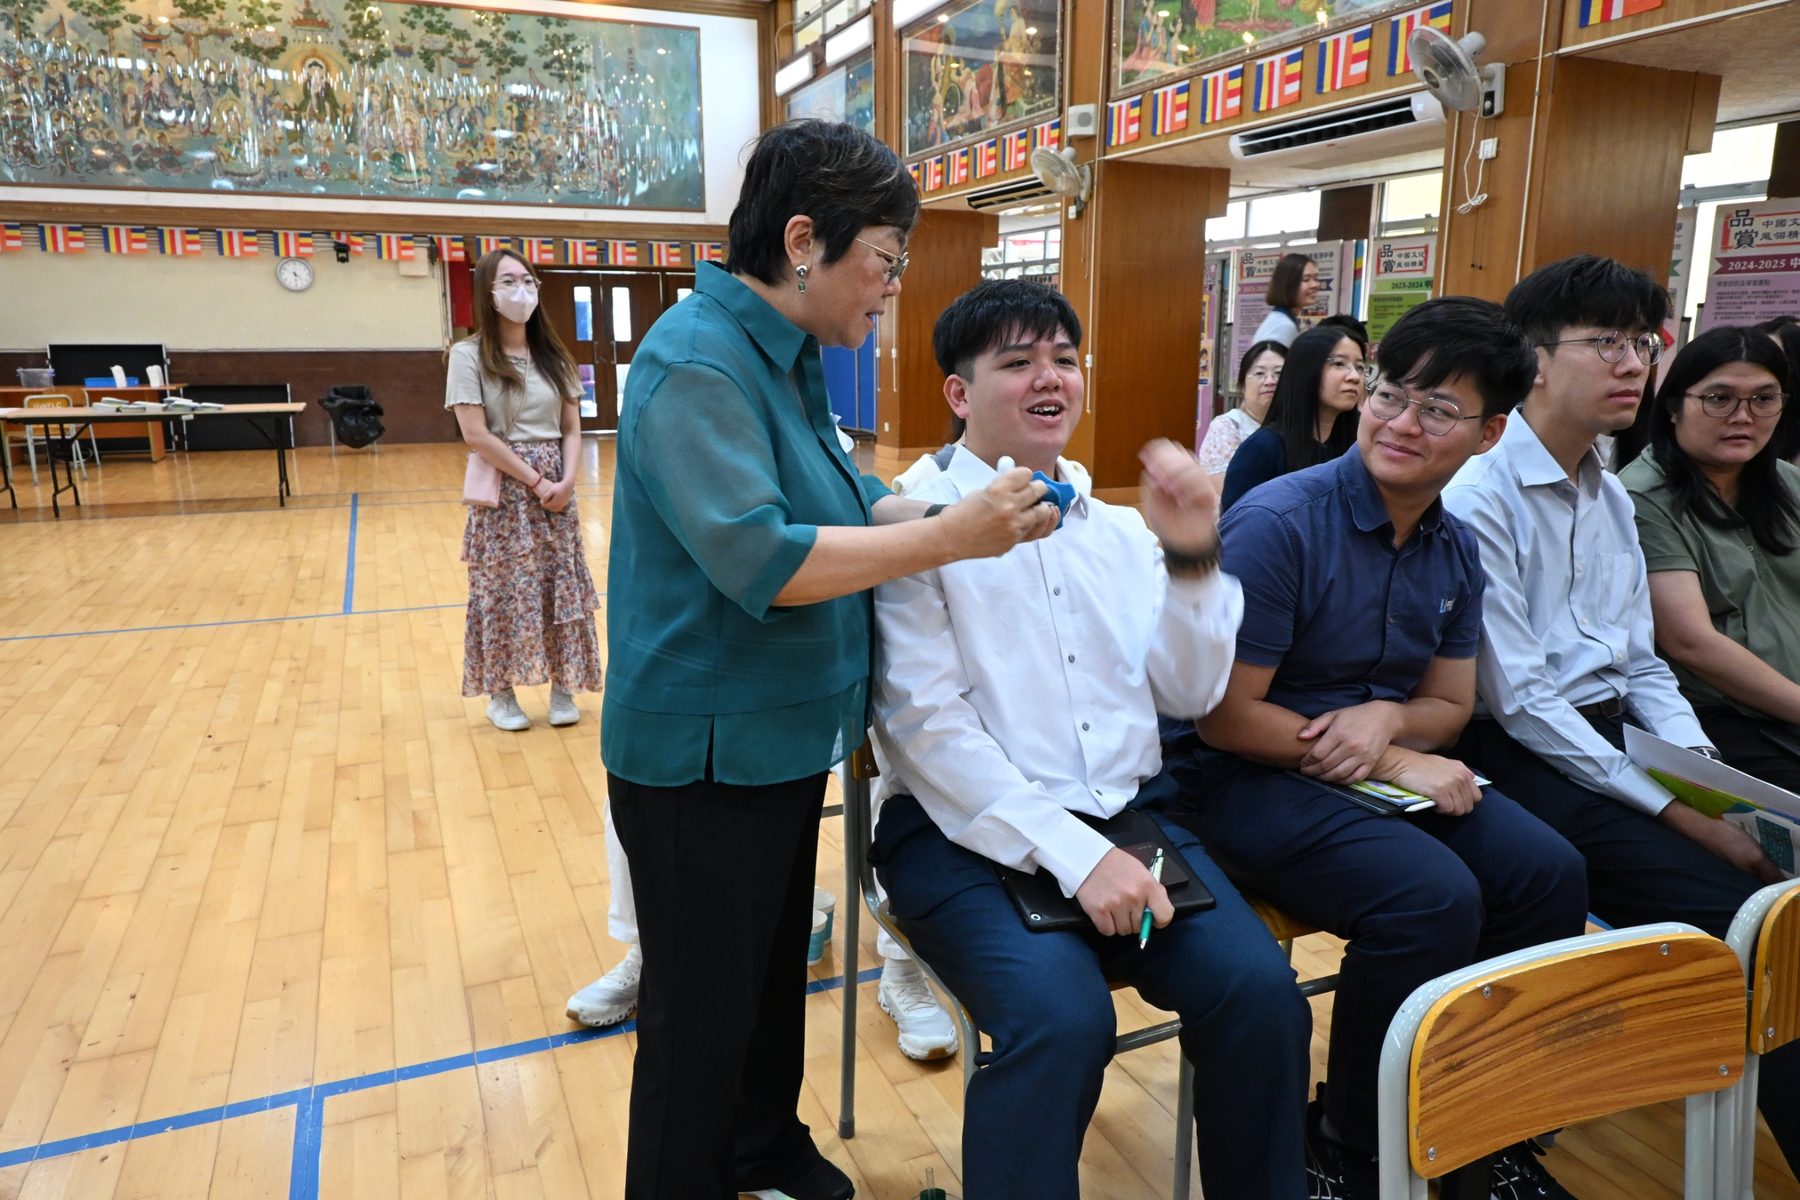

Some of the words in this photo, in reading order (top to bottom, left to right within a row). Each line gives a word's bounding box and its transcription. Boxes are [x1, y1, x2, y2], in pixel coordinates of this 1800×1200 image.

[1729, 208, 1758, 249] 品賞
[1380, 244, 1396, 273] 品賞
[1727, 259, 1786, 271] 2024-2025
